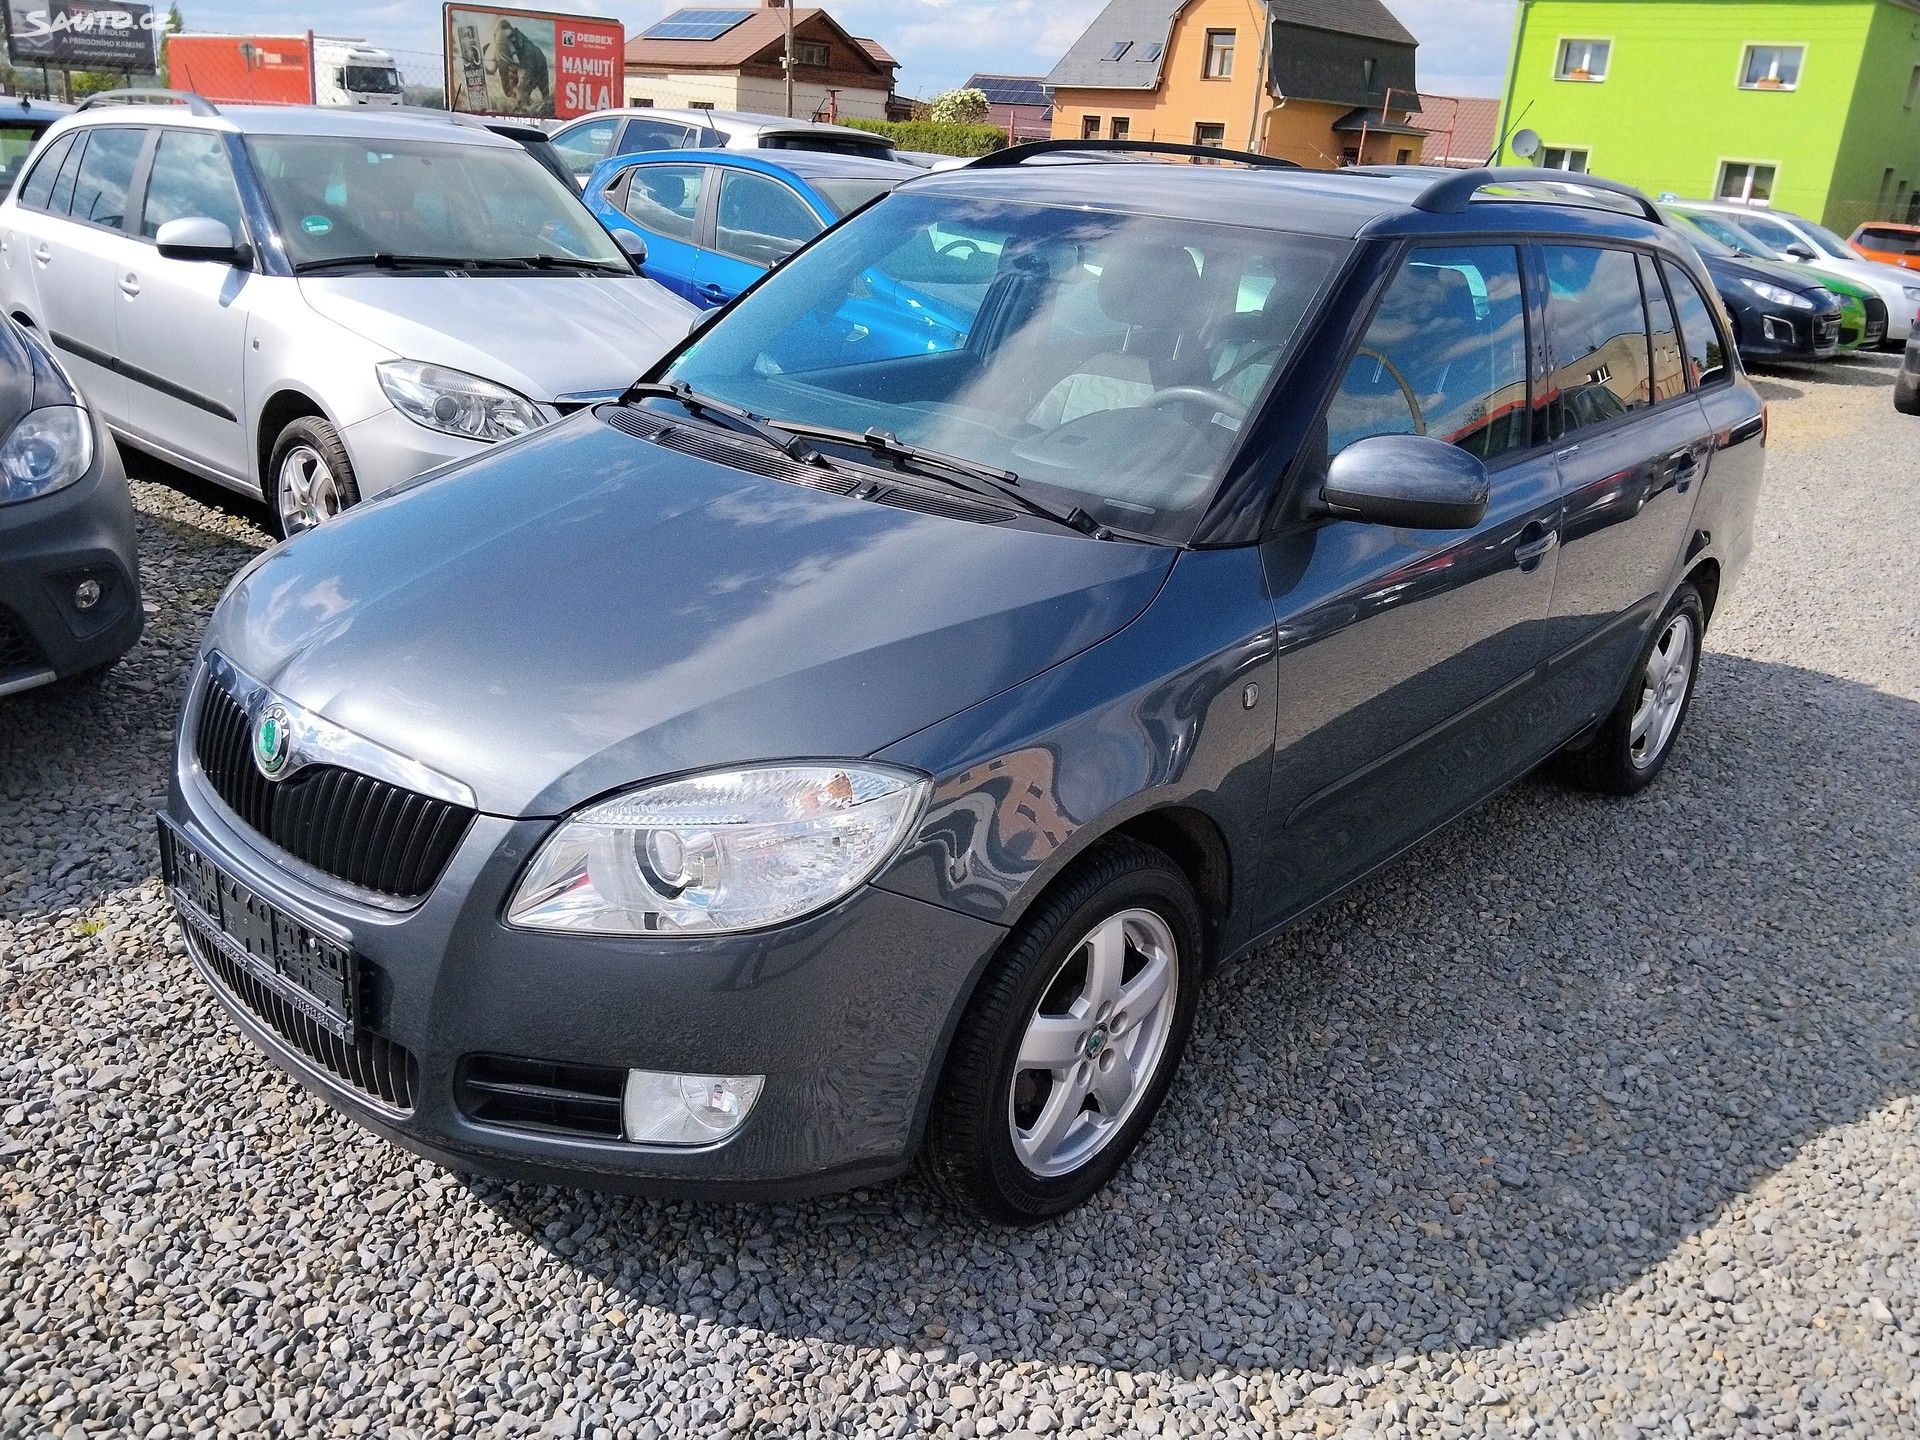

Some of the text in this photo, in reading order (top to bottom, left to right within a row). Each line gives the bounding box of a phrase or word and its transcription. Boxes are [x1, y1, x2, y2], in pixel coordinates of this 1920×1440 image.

[577, 32, 613, 45] DEBBEX
[562, 55, 615, 78] MAMUTÍ
[565, 77, 612, 111] SÍLA
